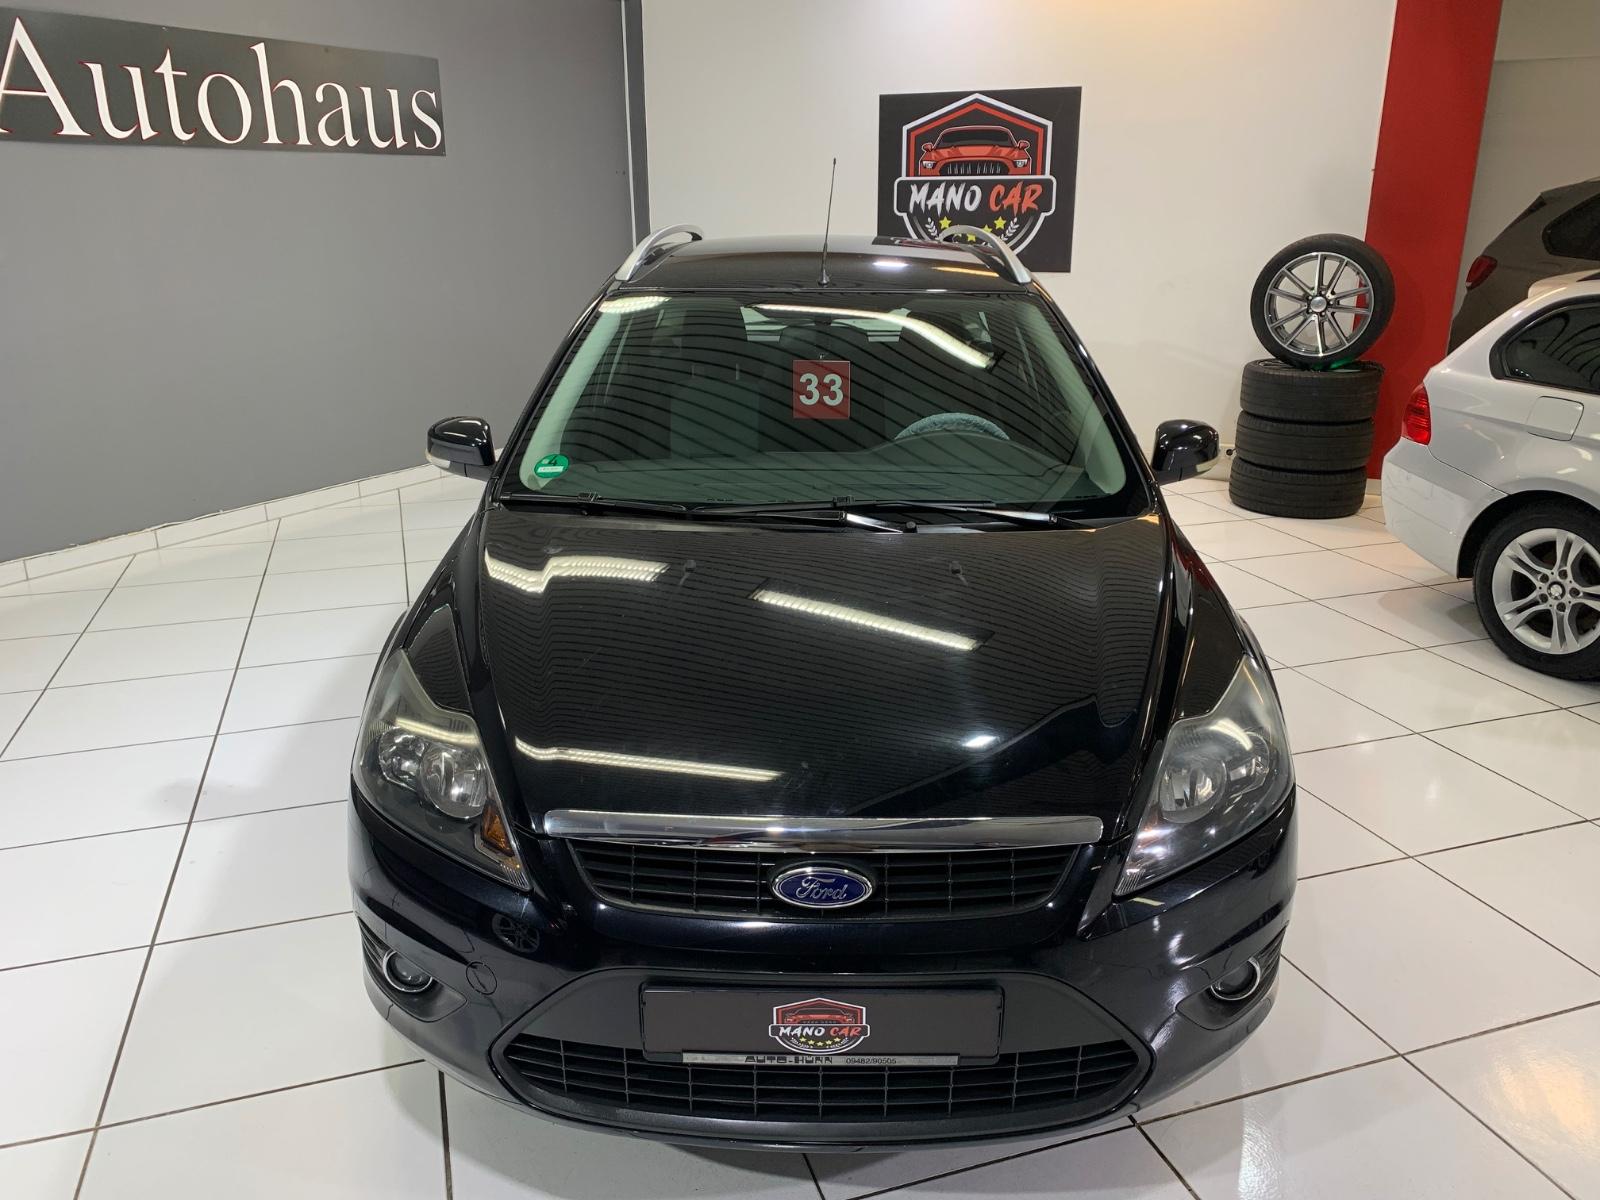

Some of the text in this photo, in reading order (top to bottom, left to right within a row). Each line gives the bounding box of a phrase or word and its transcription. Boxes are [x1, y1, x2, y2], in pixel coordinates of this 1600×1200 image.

[0, 16, 442, 150] Autohaus
[908, 181, 1043, 216] MANO CAR
[799, 372, 844, 406] 33
[548, 455, 558, 466] 4
[796, 876, 849, 900] Ford
[779, 1026, 862, 1037] MANO CAR
